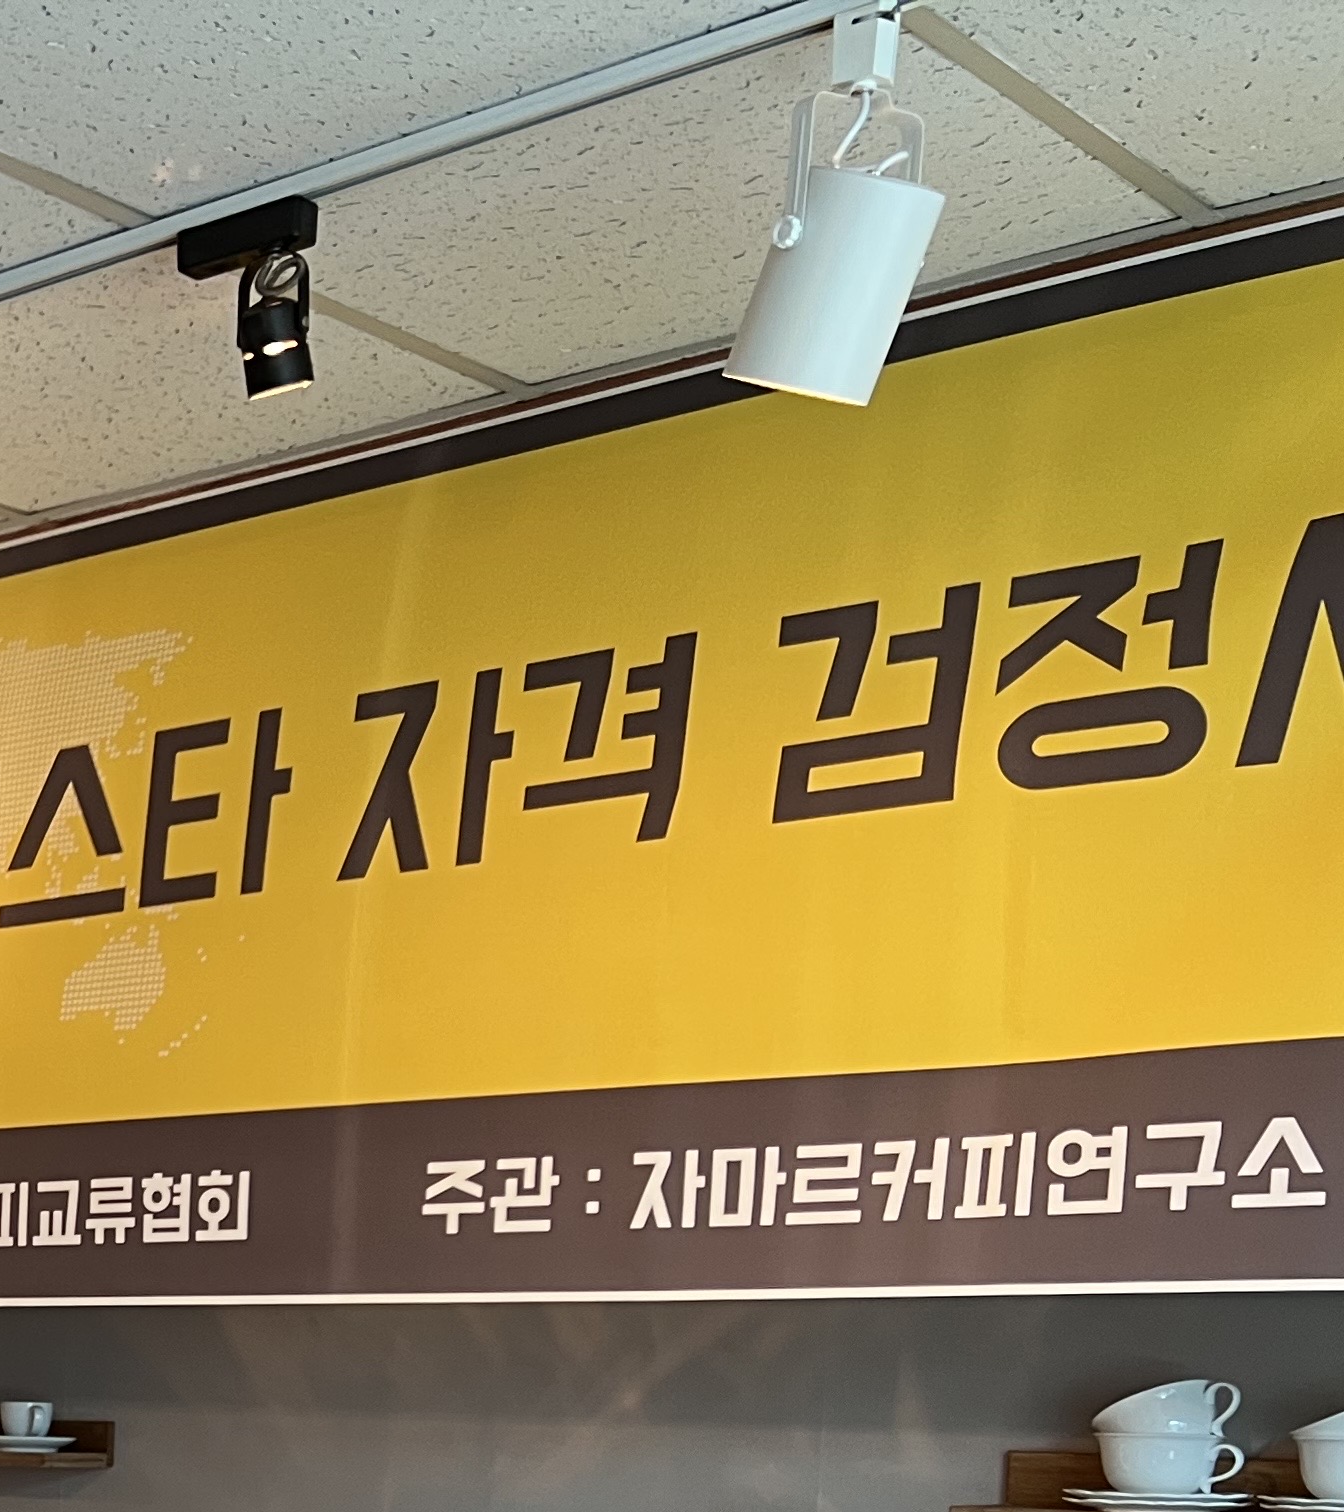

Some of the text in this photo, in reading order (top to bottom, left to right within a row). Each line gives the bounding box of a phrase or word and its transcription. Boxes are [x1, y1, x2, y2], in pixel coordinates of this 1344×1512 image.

[336, 631, 698, 881] 자격
[421, 1155, 560, 1236] 주관
[629, 1115, 1327, 1230] 자마르커피연구소
